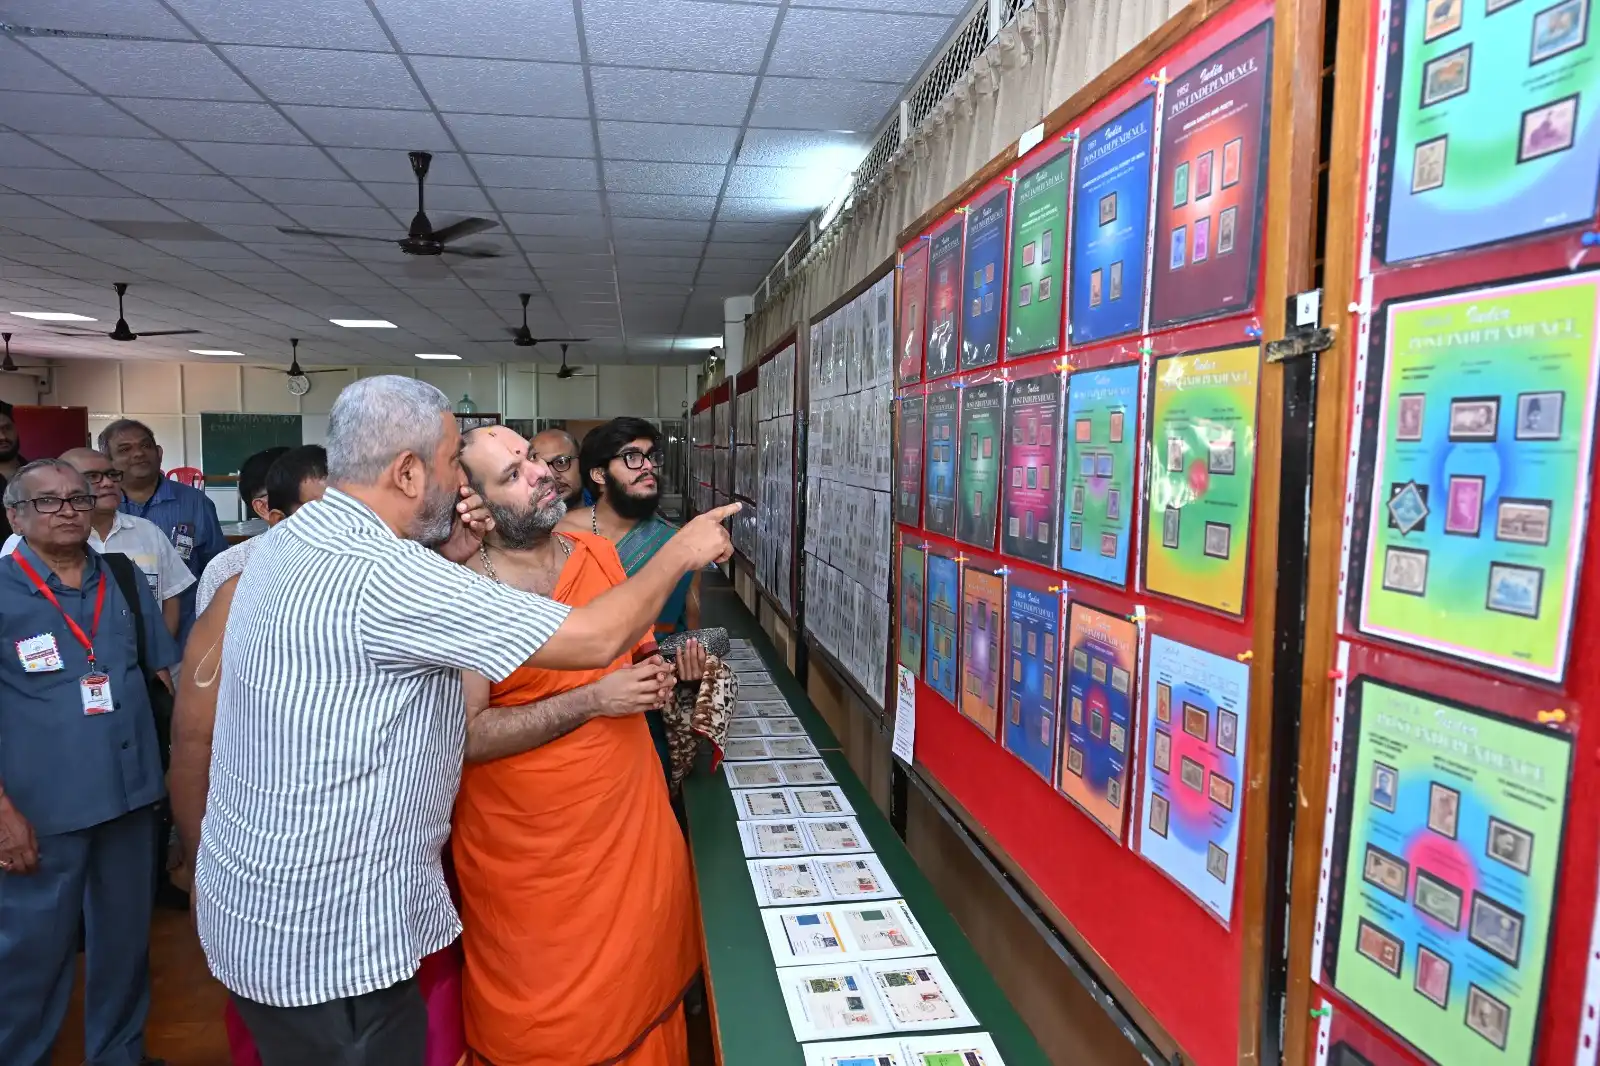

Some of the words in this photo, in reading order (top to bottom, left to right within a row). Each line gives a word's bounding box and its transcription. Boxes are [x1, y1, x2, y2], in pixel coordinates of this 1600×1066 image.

[1171, 94, 1189, 115] POST
[1190, 57, 1255, 104] INDEPENDENCE
[1199, 63, 1223, 84] India
[1083, 149, 1097, 166] POST
[1097, 121, 1145, 158] INDEPENDENCE
[1104, 124, 1122, 141] India
